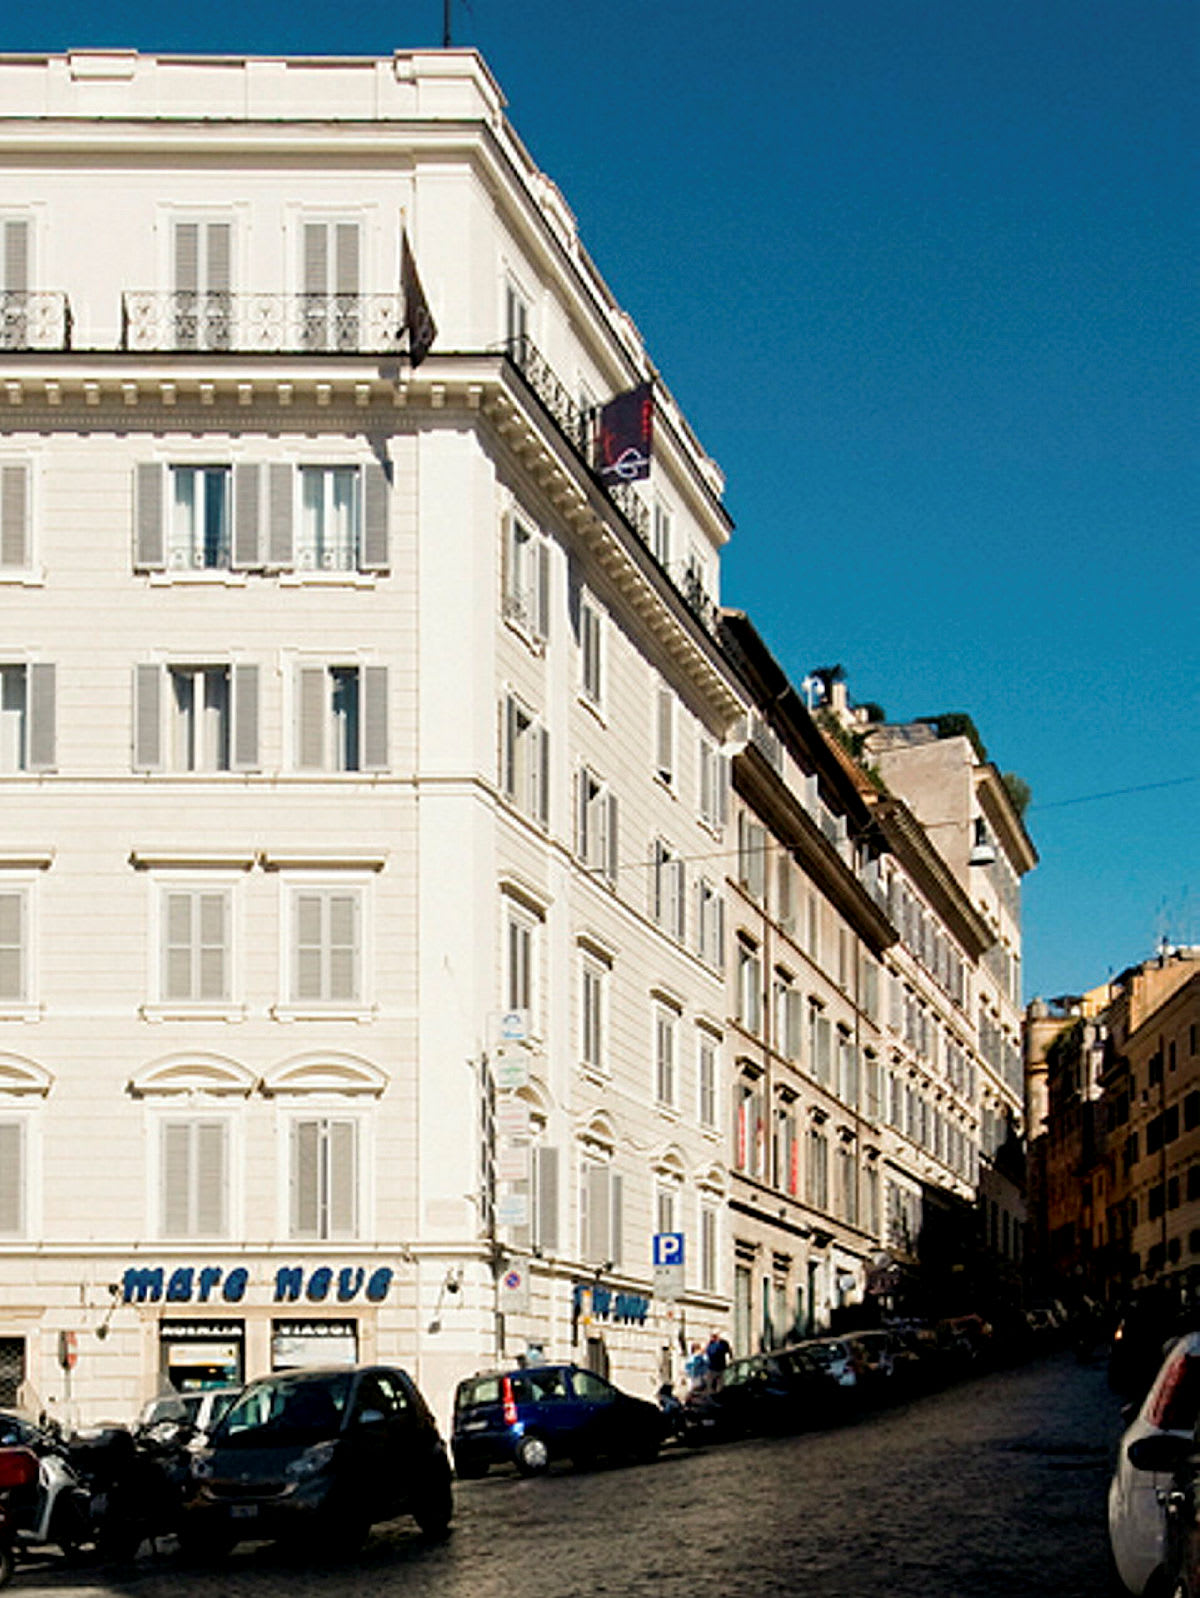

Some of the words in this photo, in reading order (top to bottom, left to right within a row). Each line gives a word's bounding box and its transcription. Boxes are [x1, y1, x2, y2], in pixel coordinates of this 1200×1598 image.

[659, 1236, 680, 1262] P
[122, 1266, 249, 1303] mare
[273, 1266, 395, 1303] neve
